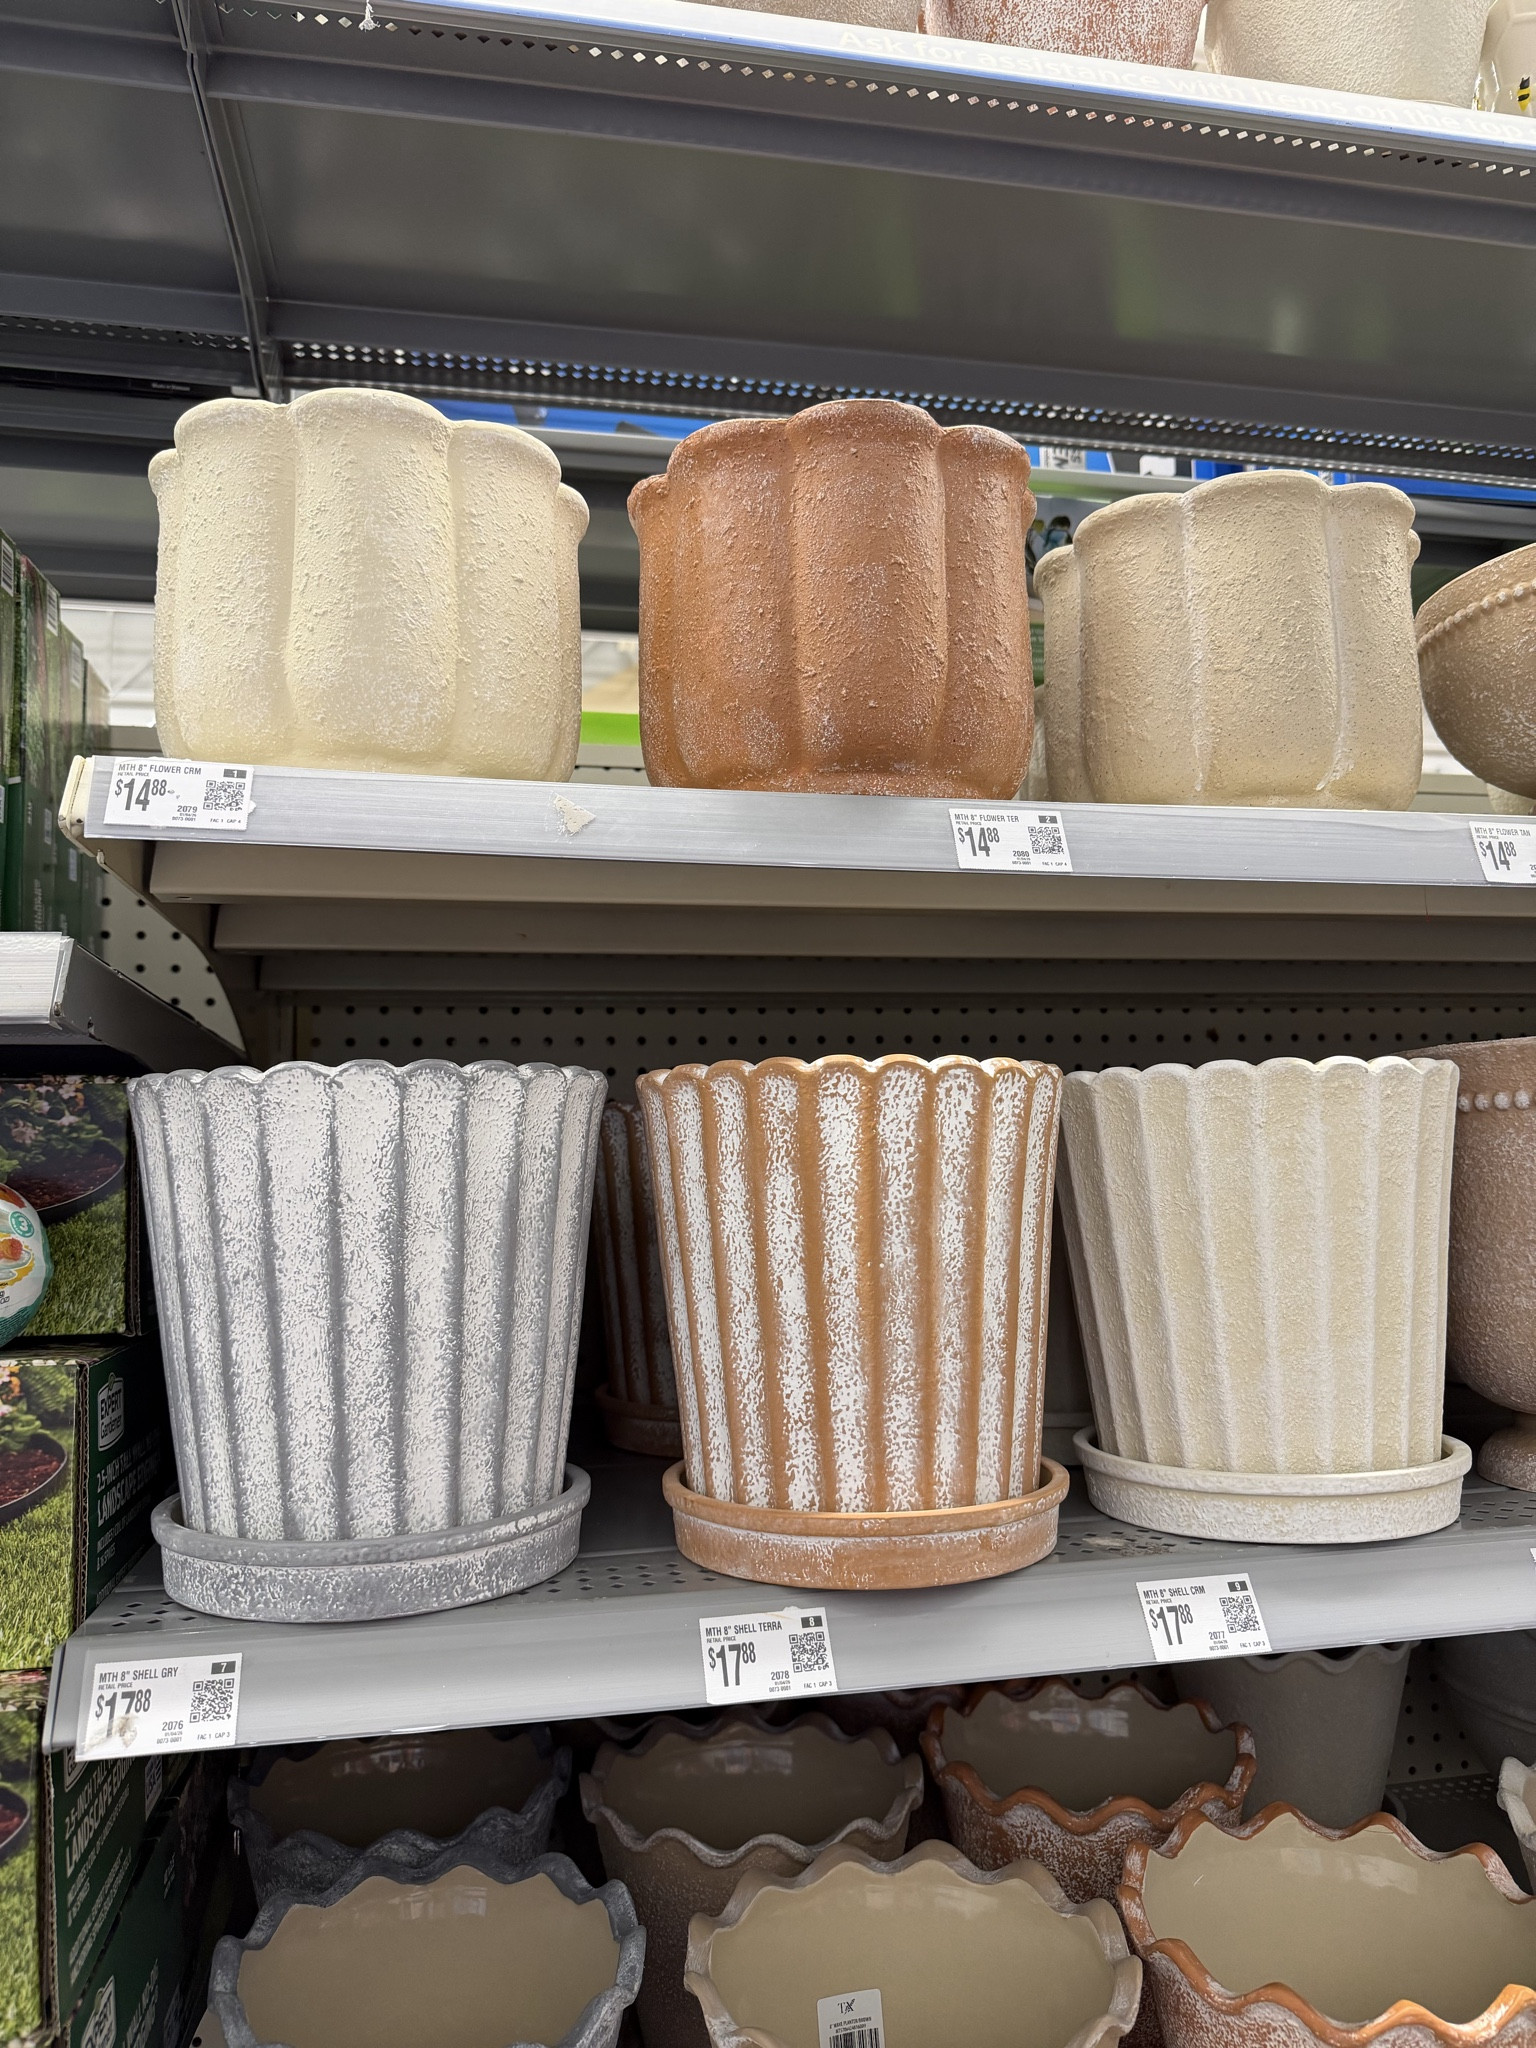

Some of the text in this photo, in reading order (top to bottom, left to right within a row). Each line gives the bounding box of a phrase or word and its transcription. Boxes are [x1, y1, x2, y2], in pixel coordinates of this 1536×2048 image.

[839, 31, 906, 55] Ask
[913, 40, 967, 63] for
[977, 52, 1160, 88] assistance
[1167, 77, 1246, 102] with
[1355, 104, 1399, 122] on
[1403, 108, 1461, 130] the
[1466, 117, 1524, 139] top
[118, 764, 136, 772] MTH
[150, 764, 181, 774] FLOWER
[184, 766, 202, 775] CRM
[177, 804, 198, 813] 2079
[101, 1388, 122, 1420] EXPERT
[101, 1415, 122, 1440] Gardener
[98, 1468, 136, 1528] LANDSCAPE
[1143, 1590, 1158, 1599] MTH
[1168, 1587, 1190, 1597] SHELL
[1190, 1585, 1206, 1595] CRM
[1234, 1582, 1240, 1590] 9
[809, 1617, 815, 1626] 8
[706, 1627, 722, 1637] MTH
[734, 1623, 757, 1634] SHELL
[758, 1621, 782, 1632] TERRA
[1209, 1631, 1224, 1640] 2077
[221, 1663, 227, 1672] 7
[99, 1672, 118, 1684] MTH
[133, 1669, 158, 1680] SHELL
[161, 1667, 179, 1678] GRY
[771, 1670, 790, 1681] 2078
[162, 1720, 184, 1731] 2076
[92, 1760, 107, 1794] TALL
[66, 1772, 112, 1878] LANDSCAPE
